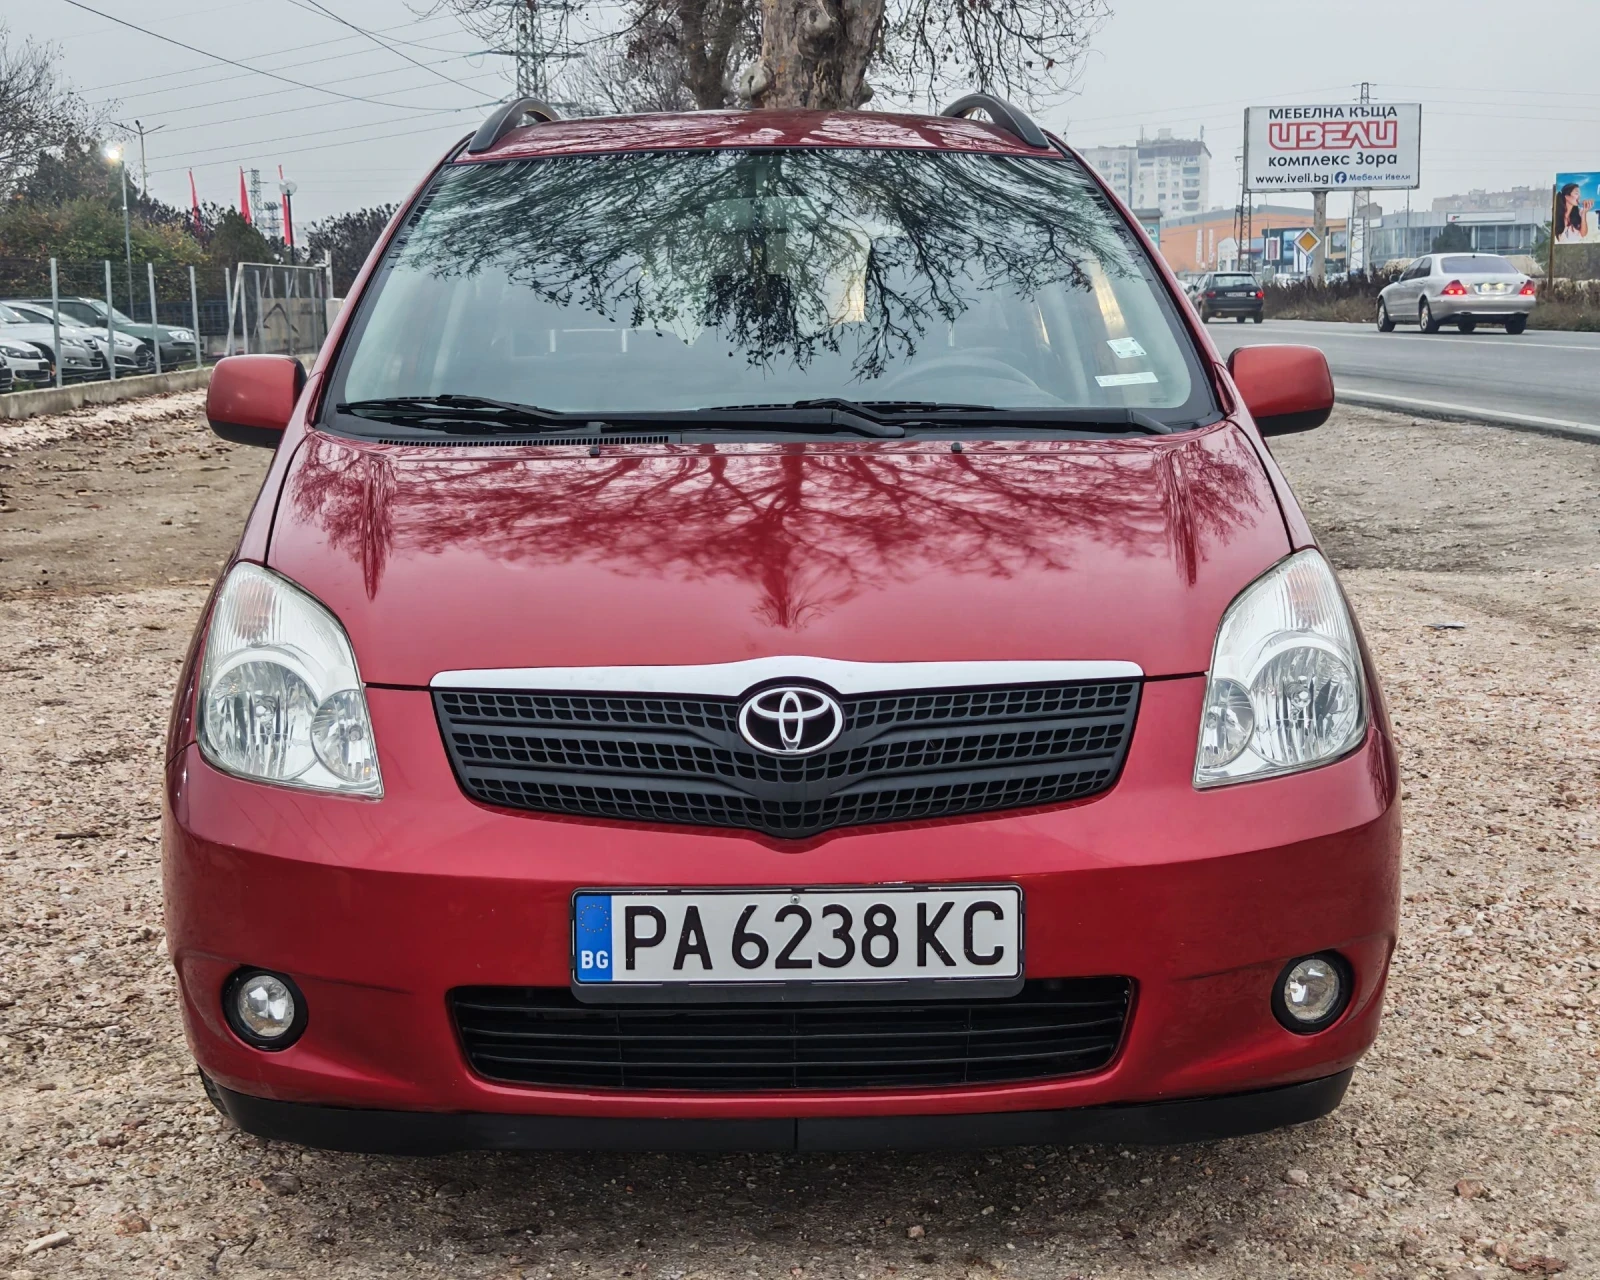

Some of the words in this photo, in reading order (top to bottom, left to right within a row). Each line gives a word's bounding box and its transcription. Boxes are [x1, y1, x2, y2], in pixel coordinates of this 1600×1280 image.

[1269, 108, 1344, 119] МЕБЕЛНА
[1349, 106, 1397, 119] КЪЩА
[1269, 121, 1397, 150] ИВЕЛИ
[1268, 155, 1350, 167] комплекс
[1356, 152, 1397, 168] Зора
[1255, 173, 1329, 184] www.iveli.bg
[1349, 173, 1383, 181] Мебели
[1385, 173, 1411, 181] Ивели
[624, 905, 713, 970] PA
[731, 903, 899, 969] 6238
[916, 901, 1005, 967] KC
[581, 950, 609, 969] BG
